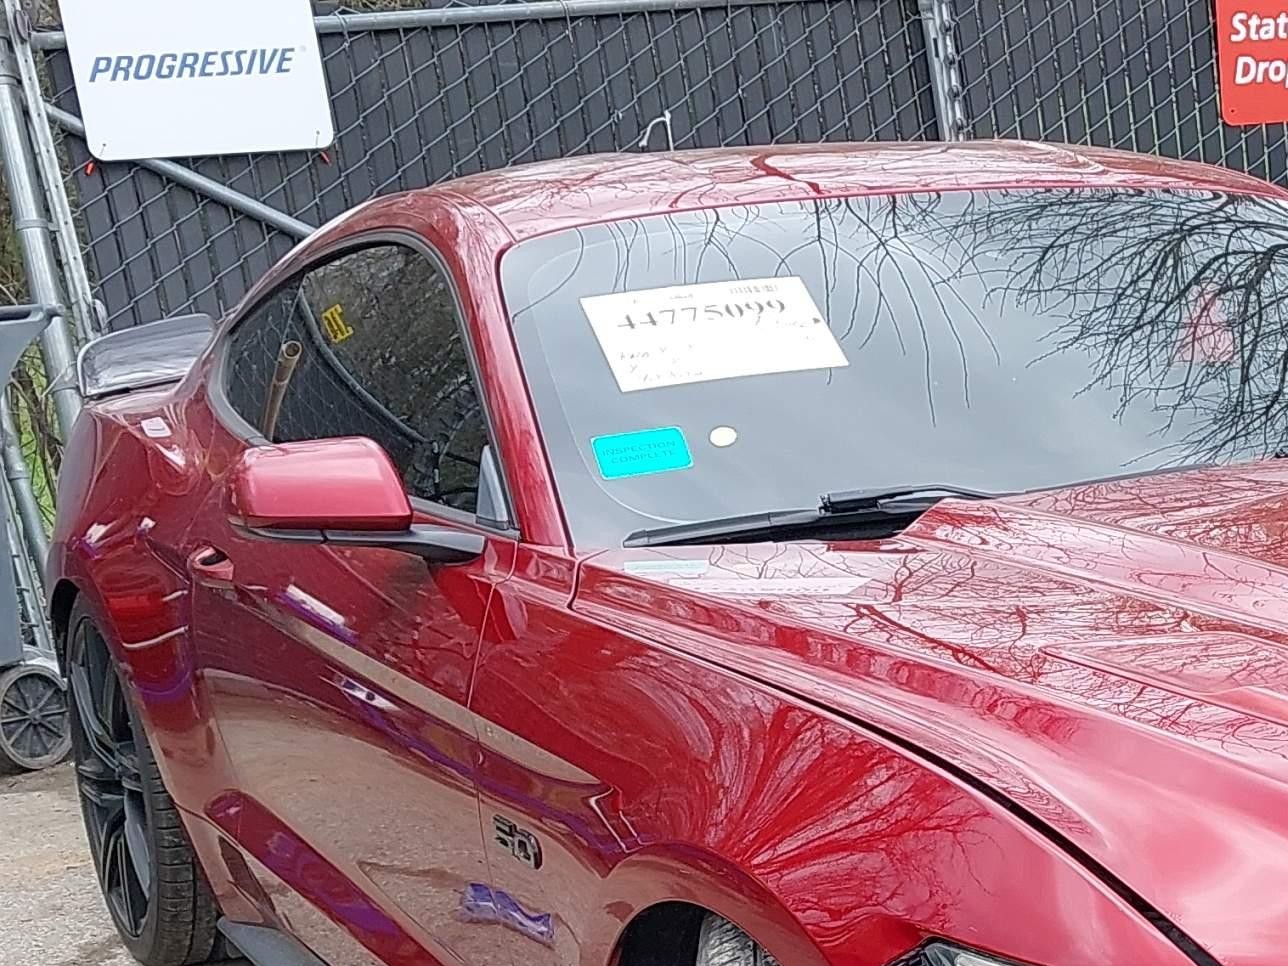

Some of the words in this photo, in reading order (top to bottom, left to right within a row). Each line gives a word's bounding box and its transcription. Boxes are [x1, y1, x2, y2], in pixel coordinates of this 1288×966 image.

[88, 47, 295, 82] PROGRESSIVE
[602, 440, 676, 456] INSPECTION
[611, 449, 676, 464] COMPLETE
